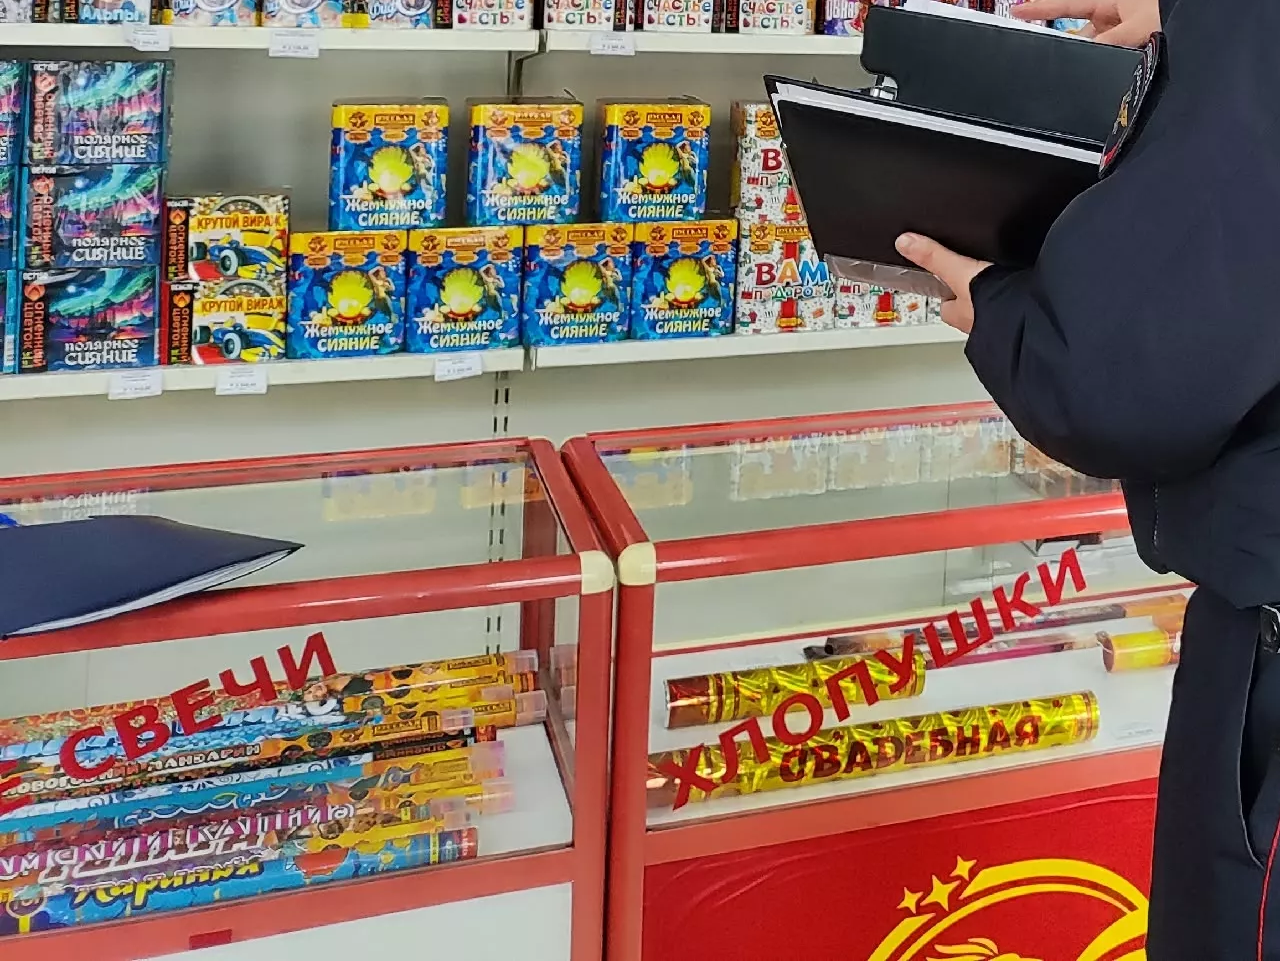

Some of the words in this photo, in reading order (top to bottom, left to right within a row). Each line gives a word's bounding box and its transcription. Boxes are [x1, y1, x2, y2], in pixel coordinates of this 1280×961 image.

[345, 197, 433, 213] Жемчужное
[484, 192, 569, 208] Жемчужное
[618, 190, 696, 206] Жемчужное
[358, 211, 421, 227] СИЯНИЕ
[497, 206, 556, 220] СИЯНИЕ
[629, 204, 684, 218] СИЯНИЕ
[197, 212, 241, 230] КРУТОЙ
[242, 213, 282, 229] ВИРАЖ
[754, 258, 829, 287] ВАМ
[201, 296, 245, 313] КРУТОЙ
[246, 295, 286, 311] ВИРАЖ
[539, 310, 621, 326] Жемчужное
[644, 307, 722, 322] Жемчужное
[23, 302, 34, 349] ЦВЕТОК
[33, 301, 45, 366] ОГНЕННЫЙ
[304, 320, 394, 338] Жемчужное
[417, 318, 503, 335] Жемчужное
[550, 324, 608, 339] СИЯНИЕ
[655, 319, 710, 334] СИЯНИЕ
[317, 336, 380, 352] СИЯНИЕ
[429, 332, 490, 348] СИЯНИЕ
[660, 547, 1089, 811] ХЛОПУШКИ
[59, 631, 338, 780] СВЕЧИ
[779, 715, 1043, 784] СВАДЕБНАЯ
